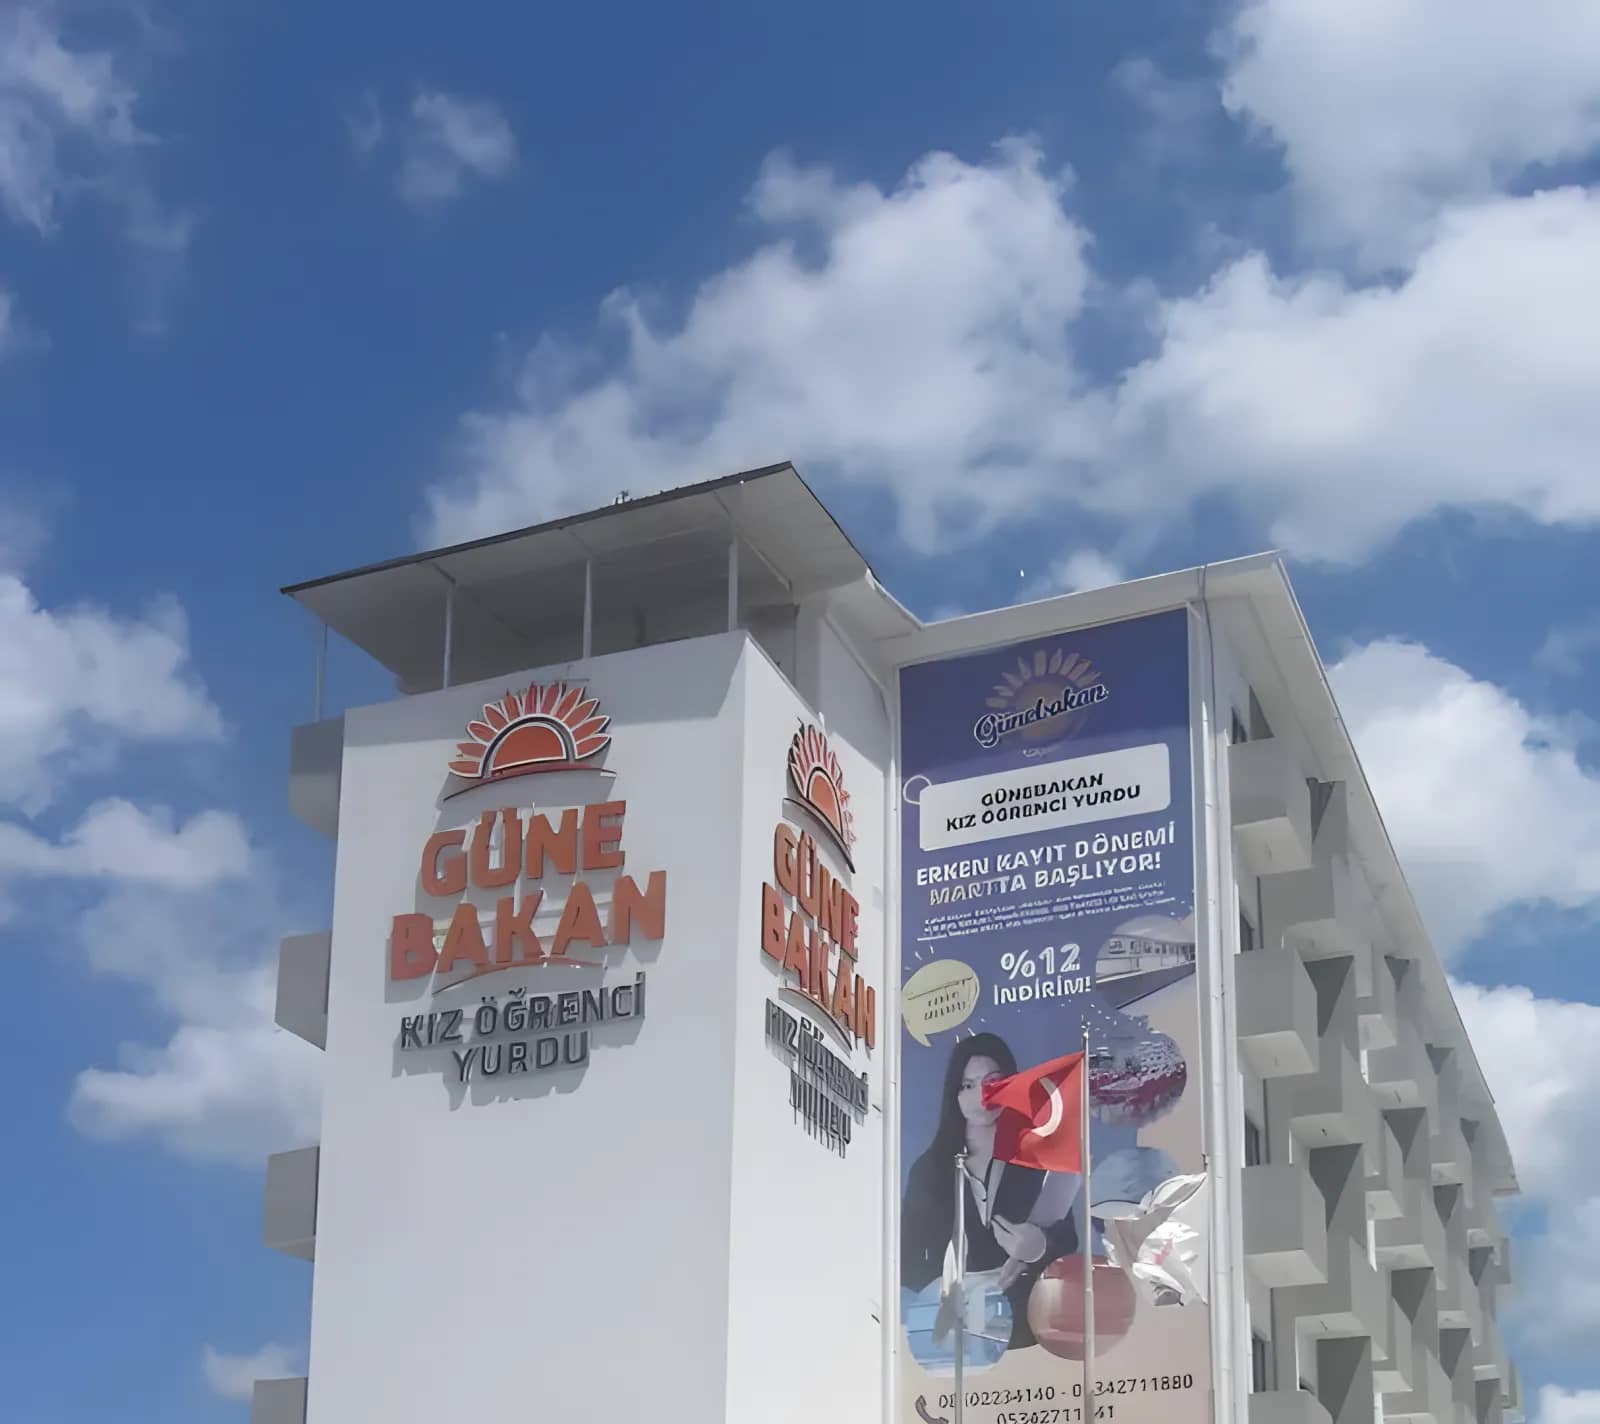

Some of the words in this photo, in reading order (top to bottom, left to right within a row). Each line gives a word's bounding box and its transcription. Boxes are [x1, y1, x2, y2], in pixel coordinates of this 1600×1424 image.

[946, 814, 976, 832] KIZ
[1072, 785, 1141, 807] YURDU
[421, 800, 626, 896] GÜNE
[916, 857, 989, 886] ERKEN
[997, 844, 1067, 871] KAYIT
[1075, 821, 1176, 858] DÖNEMİ
[1035, 852, 1161, 887] BAŞLIYOR!
[391, 870, 667, 981] BAKAN
[761, 881, 876, 1050] BAKAN
[1000, 943, 1081, 980] %12
[401, 1010, 464, 1049] KIZ
[476, 971, 647, 1036] ÖĞRENCİ
[993, 976, 1092, 1005] İNDİRİM!
[452, 1031, 589, 1083] YURDU
[1072, 1374, 1193, 1397] 0342711880
